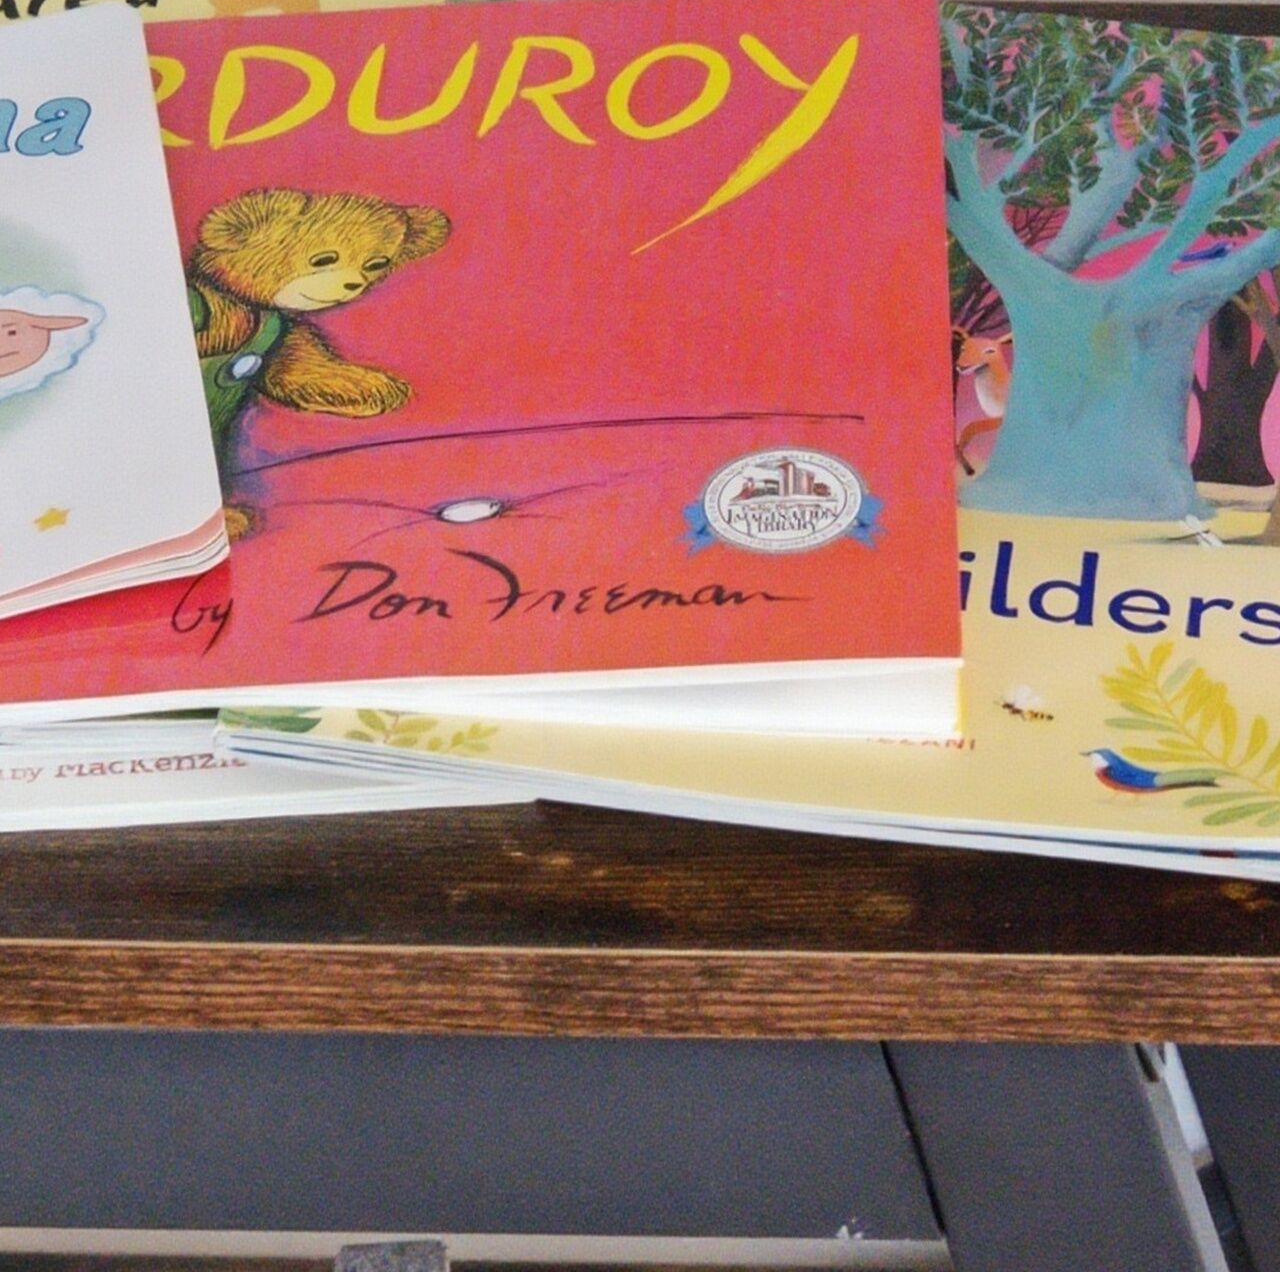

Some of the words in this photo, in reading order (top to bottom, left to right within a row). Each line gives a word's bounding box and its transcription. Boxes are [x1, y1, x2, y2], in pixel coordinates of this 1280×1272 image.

[171, 573, 236, 655] by
[292, 560, 454, 624] Don
[445, 548, 814, 624] Freeman
